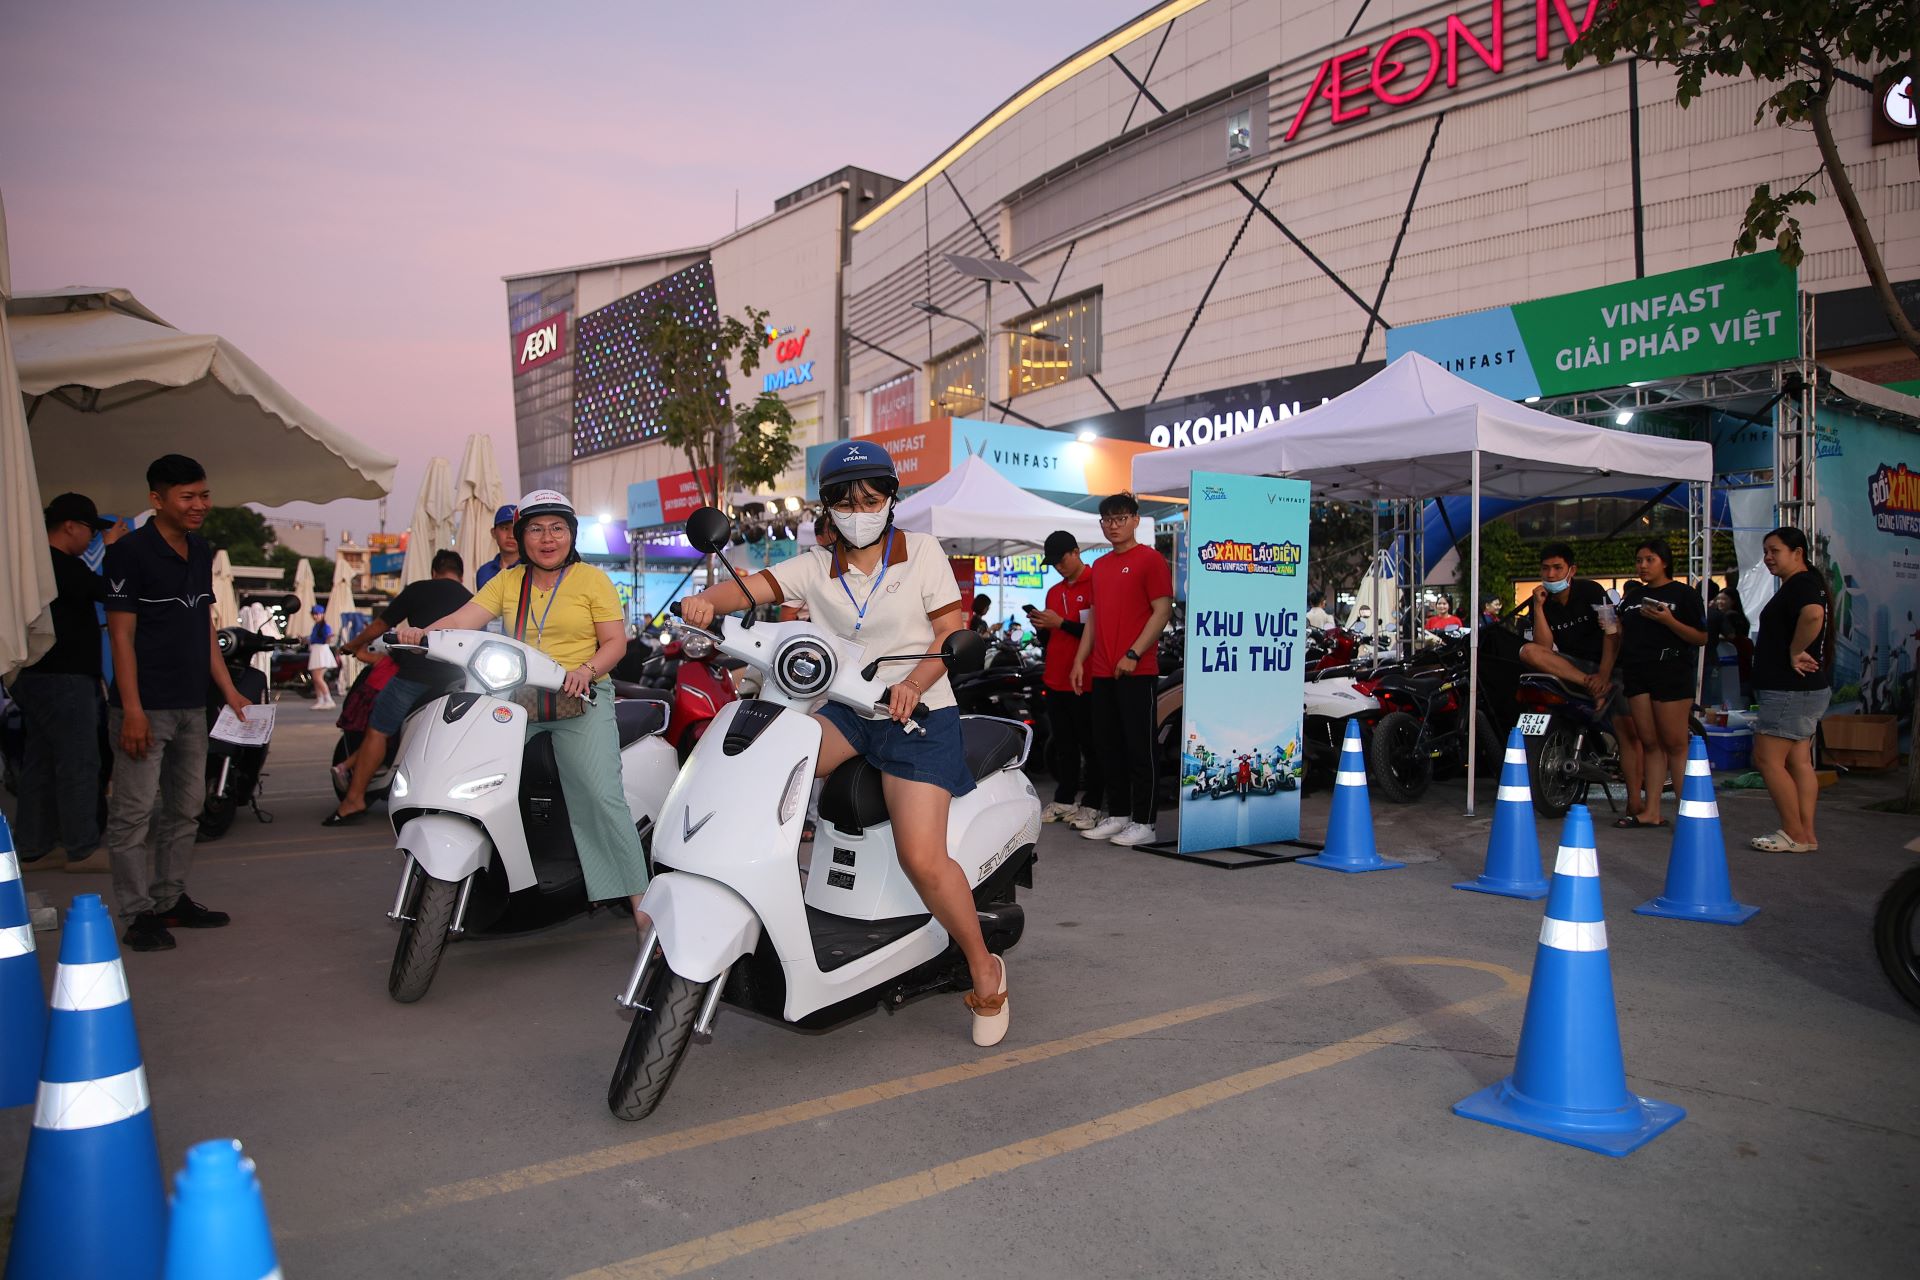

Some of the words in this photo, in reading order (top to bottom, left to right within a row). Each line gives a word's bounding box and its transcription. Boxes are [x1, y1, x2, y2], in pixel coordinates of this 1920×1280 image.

[1601, 284, 1725, 328] VINFAST
[1555, 336, 1610, 371] GIẢI
[1620, 324, 1700, 361] PHÁP
[1710, 309, 1782, 346] VIỆT
[763, 362, 814, 393] IMAX
[895, 458, 918, 474] ANH
[994, 450, 1058, 469] VINFAST
[1279, 496, 1306, 504] VINFAST
[1215, 540, 1252, 561] XĂNG
[1196, 611, 1243, 636] KHU
[1255, 607, 1298, 642] VỰC
[1249, 641, 1294, 672] THỬ
[1522, 714, 1546, 725] 52-L4
